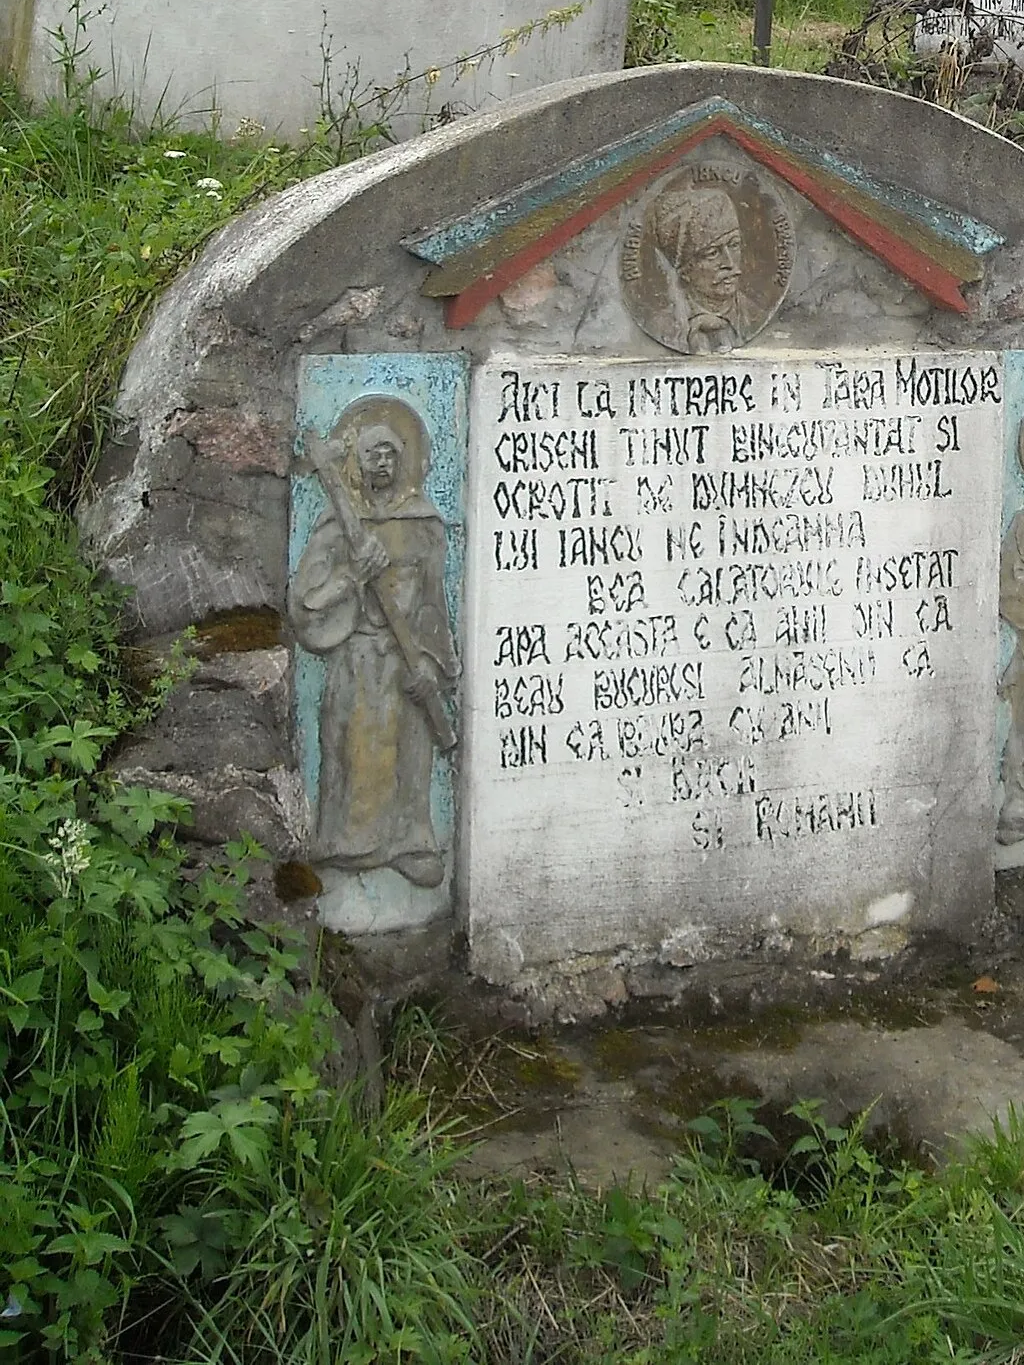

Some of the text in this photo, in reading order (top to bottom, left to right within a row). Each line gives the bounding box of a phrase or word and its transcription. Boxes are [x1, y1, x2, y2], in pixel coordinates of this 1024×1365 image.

[577, 382, 617, 419] LA
[629, 373, 756, 418] INTRARE
[896, 357, 1001, 407] MOTILOR
[494, 429, 599, 473] CRISENI
[619, 425, 710, 466] TINUT
[936, 415, 961, 452] SI
[494, 528, 538, 570] LUI
[559, 524, 643, 568] IANCU
[667, 521, 705, 562] NE
[587, 570, 646, 615] BEA
[855, 549, 959, 593] INSETAT
[494, 624, 551, 667] APA
[495, 672, 564, 720] BEAU
